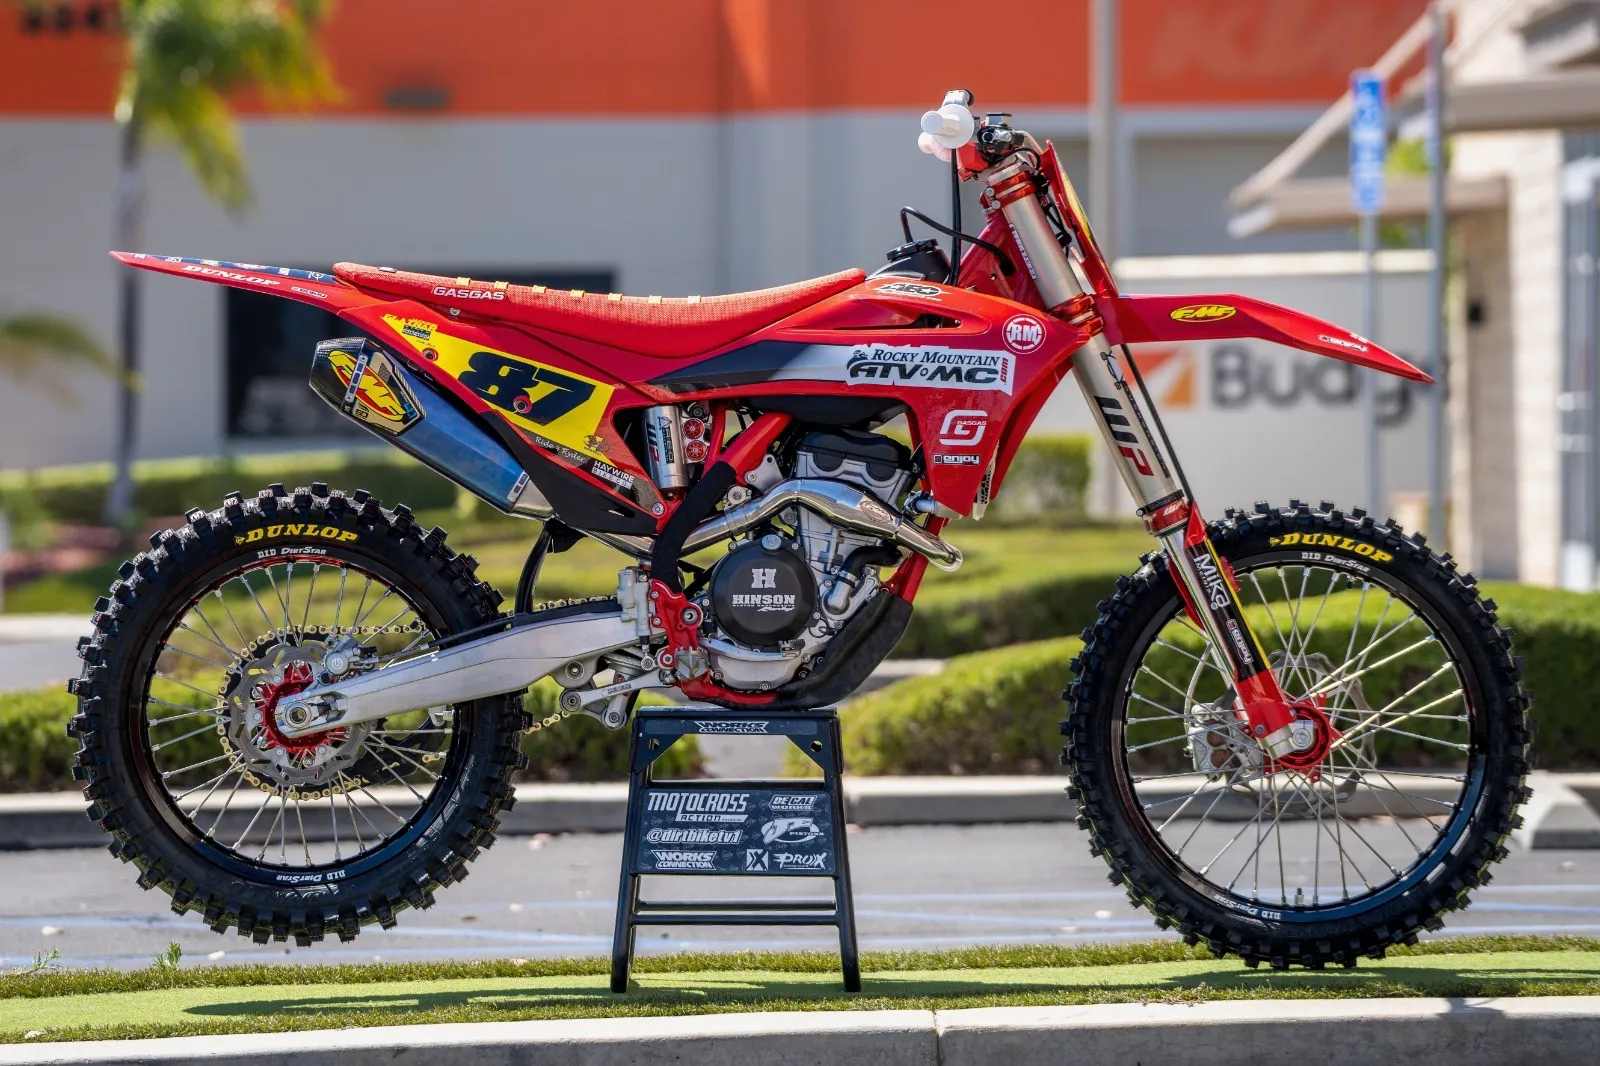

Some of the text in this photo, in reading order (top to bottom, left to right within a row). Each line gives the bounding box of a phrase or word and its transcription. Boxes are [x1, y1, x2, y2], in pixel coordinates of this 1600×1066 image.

[182, 265, 281, 285] DUNLOP
[433, 286, 506, 300] GASGAS
[1171, 304, 1237, 321] FMF
[1010, 325, 1041, 342] RM
[328, 353, 407, 417] FMF
[458, 351, 598, 427] 87
[535, 436, 555, 450] Ride
[1094, 395, 1154, 477] WP
[943, 454, 980, 465] enjoy
[593, 460, 635, 483] HAYWIRE
[245, 523, 358, 543] DUNLOP
[1280, 533, 1394, 563] DUNLOP
[751, 568, 777, 589] H
[1193, 552, 1231, 608] Mika
[732, 594, 796, 605] HINSON
[1232, 629, 1253, 665] enjoy
[647, 792, 750, 813] MOTOCROSS
[647, 827, 743, 845] @dirtbiketv1
[656, 851, 714, 860] WORKS
[656, 860, 712, 869] CONNECTION
